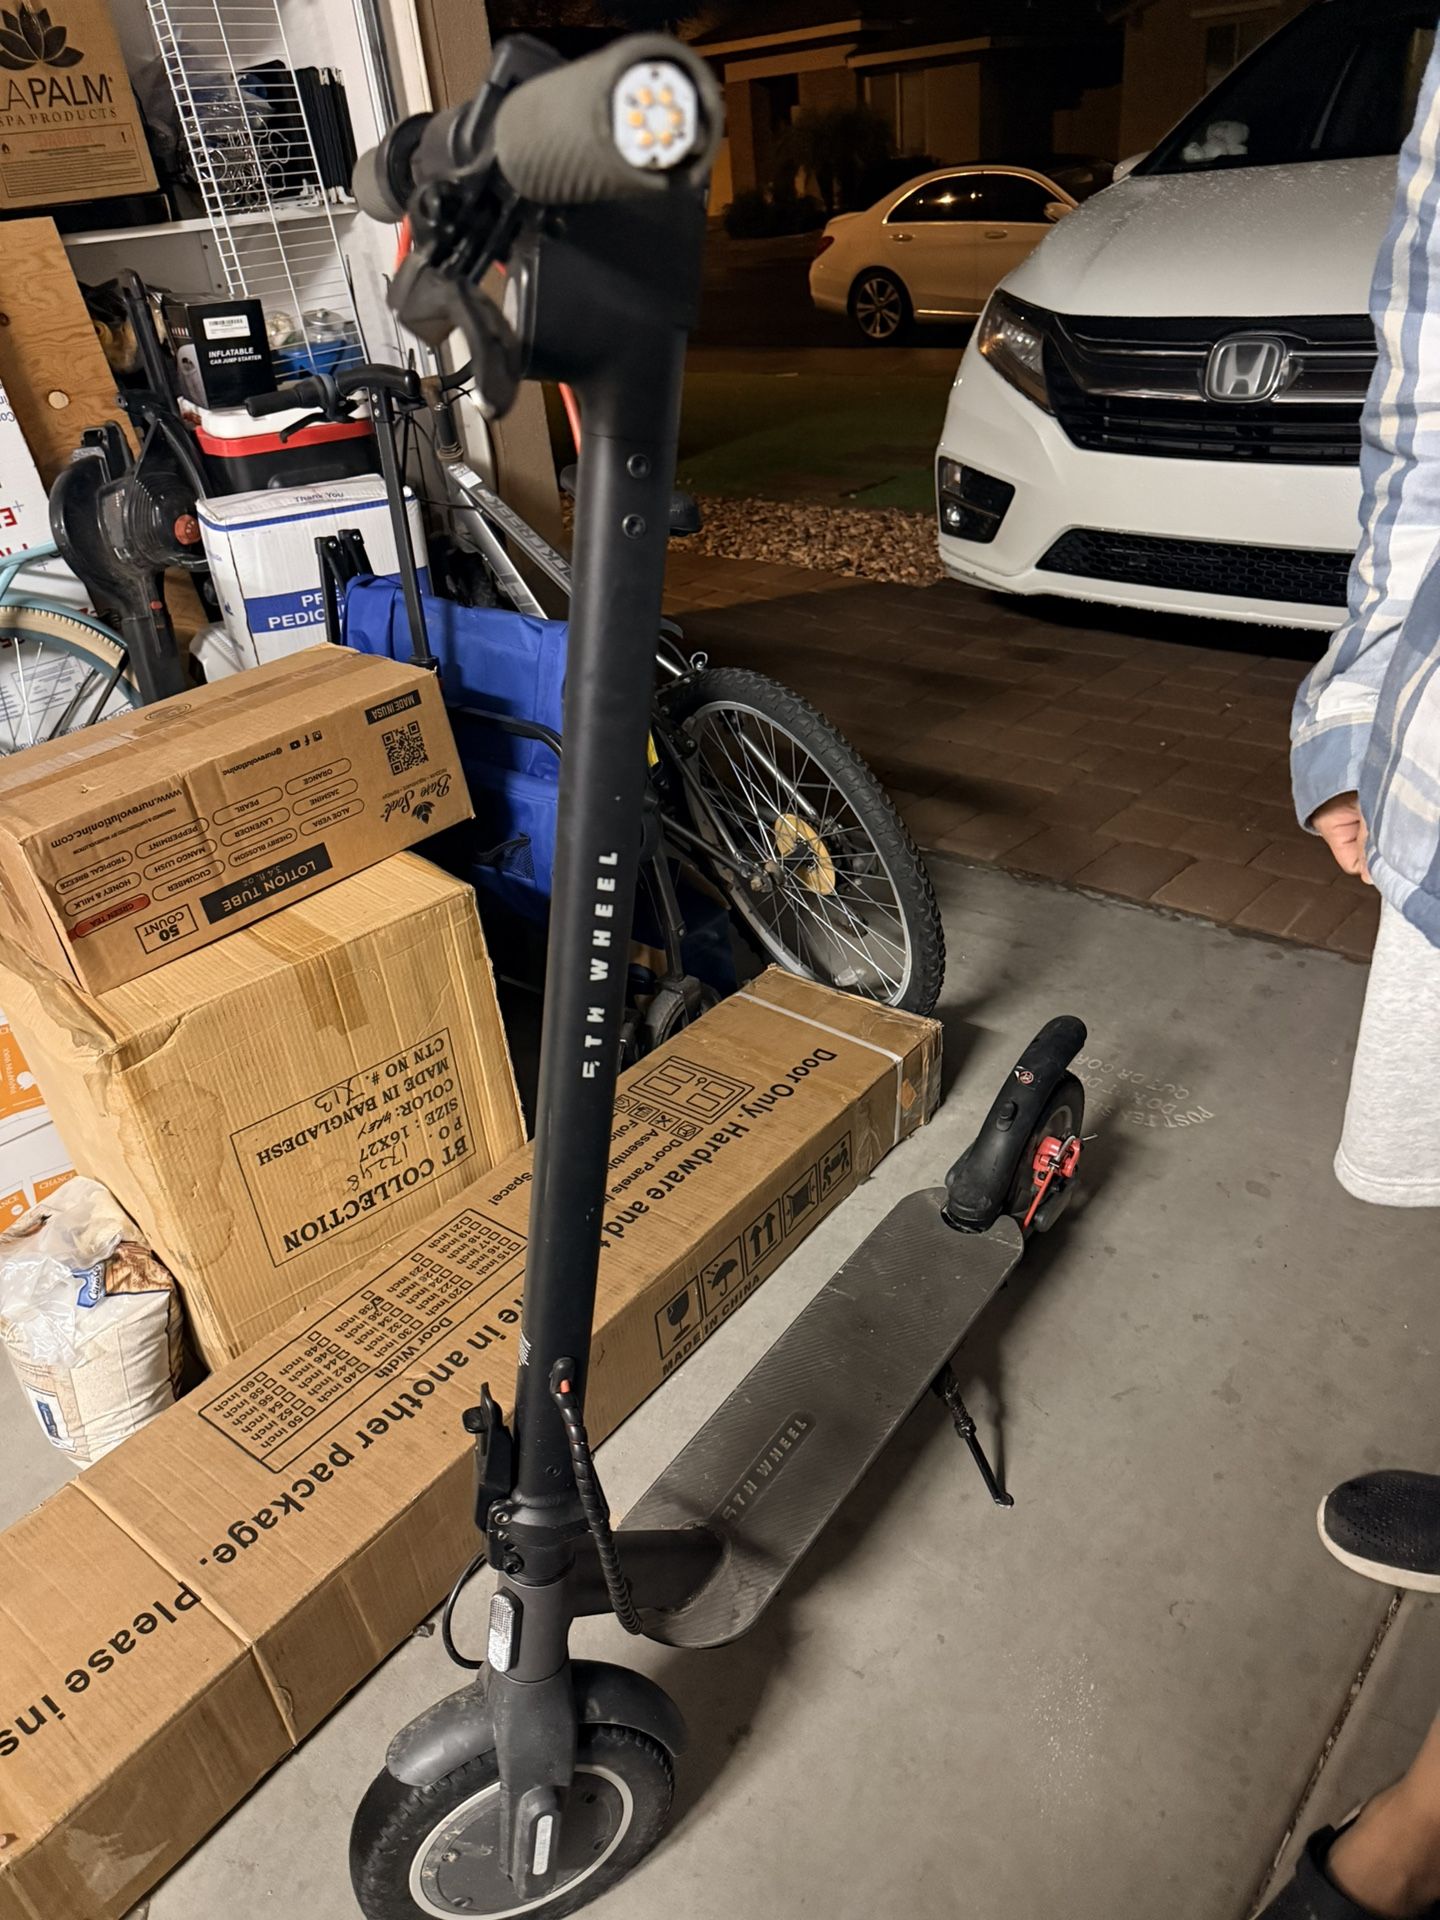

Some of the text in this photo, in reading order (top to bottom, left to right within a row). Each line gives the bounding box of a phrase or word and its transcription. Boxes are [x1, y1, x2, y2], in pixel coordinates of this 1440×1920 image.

[30, 108, 116, 124] PRODUCTS
[209, 348, 253, 357] INFLATABLE
[372, 696, 414, 719] MADE IN USA
[303, 769, 332, 784] ORANGE
[422, 774, 451, 797] Bare
[235, 800, 259, 812] PEARL
[310, 789, 339, 805] JASMINE
[51, 790, 182, 848] www.nurevolutioninc.com
[235, 817, 273, 837] LAVENDER
[312, 808, 350, 827] ALOE VERA
[149, 825, 198, 851] PEPPERMINT
[234, 833, 292, 862] CHERRY BLOSSOM
[60, 857, 126, 889] TROPICAL BREEZE
[154, 846, 206, 872] MANGO LUSH
[104, 879, 131, 896] HONEY
[168, 869, 211, 891] CUCUMBER
[222, 861, 316, 911] LOTION TUBE
[74, 896, 94, 909] MILK
[90, 904, 134, 926] GREEN TEA
[590, 852, 618, 981] WHEEL
[144, 912, 184, 936] COUNT
[159, 924, 180, 941] 50
[414, 1038, 444, 1064] CTN
[386, 1056, 409, 1077] NO
[396, 1078, 453, 1116] COLOR:
[256, 1057, 449, 1166] MADE IN BANGLADESH
[425, 1098, 458, 1126] SIZE
[608, 1116, 638, 1141] Follo
[360, 1126, 409, 1163] 16X27
[604, 1048, 837, 1238] Door Only. Hardware and
[652, 1139, 682, 1162] Door
[612, 1162, 654, 1193] Panels
[283, 1135, 468, 1253] BT COLLECTION
[428, 1224, 462, 1248] 21 inch
[438, 1230, 471, 1253] 19 inch
[447, 1235, 480, 1258] 18 inch
[457, 1240, 490, 1264] 17 inch
[466, 1246, 500, 1270] 16 inch
[476, 1251, 510, 1275] 15 inch
[387, 1276, 410, 1292] inch
[396, 1282, 420, 1298] inch
[406, 1287, 430, 1304] inch
[416, 1282, 452, 1310] 22 inch
[426, 1288, 462, 1316] 20 inch
[335, 1304, 373, 1332] 38 inch
[344, 1321, 369, 1338] inch
[354, 1316, 392, 1344] 34 inch
[663, 1274, 759, 1376] MADE IN CHINA
[364, 1322, 402, 1351] 32 inch
[374, 1328, 412, 1358] 30 inch
[374, 1317, 453, 1378] Door Width
[467, 1325, 506, 1349] in
[279, 1346, 317, 1375] 48 inch
[288, 1352, 327, 1382] 46 inch
[298, 1358, 336, 1388] 44 inch
[308, 1365, 346, 1396] 42 inch
[317, 1372, 356, 1402] 40 inch
[214, 1381, 255, 1411] 60 inch
[223, 1388, 264, 1418] 58 inch
[232, 1394, 274, 1425] 56 inch
[356, 1351, 469, 1449] another
[241, 1401, 283, 1432] 54 inch
[251, 1408, 293, 1440] 52 inch
[261, 1416, 303, 1448] 50 inch
[200, 1442, 354, 1565] package.
[65, 1582, 201, 1692] Please
